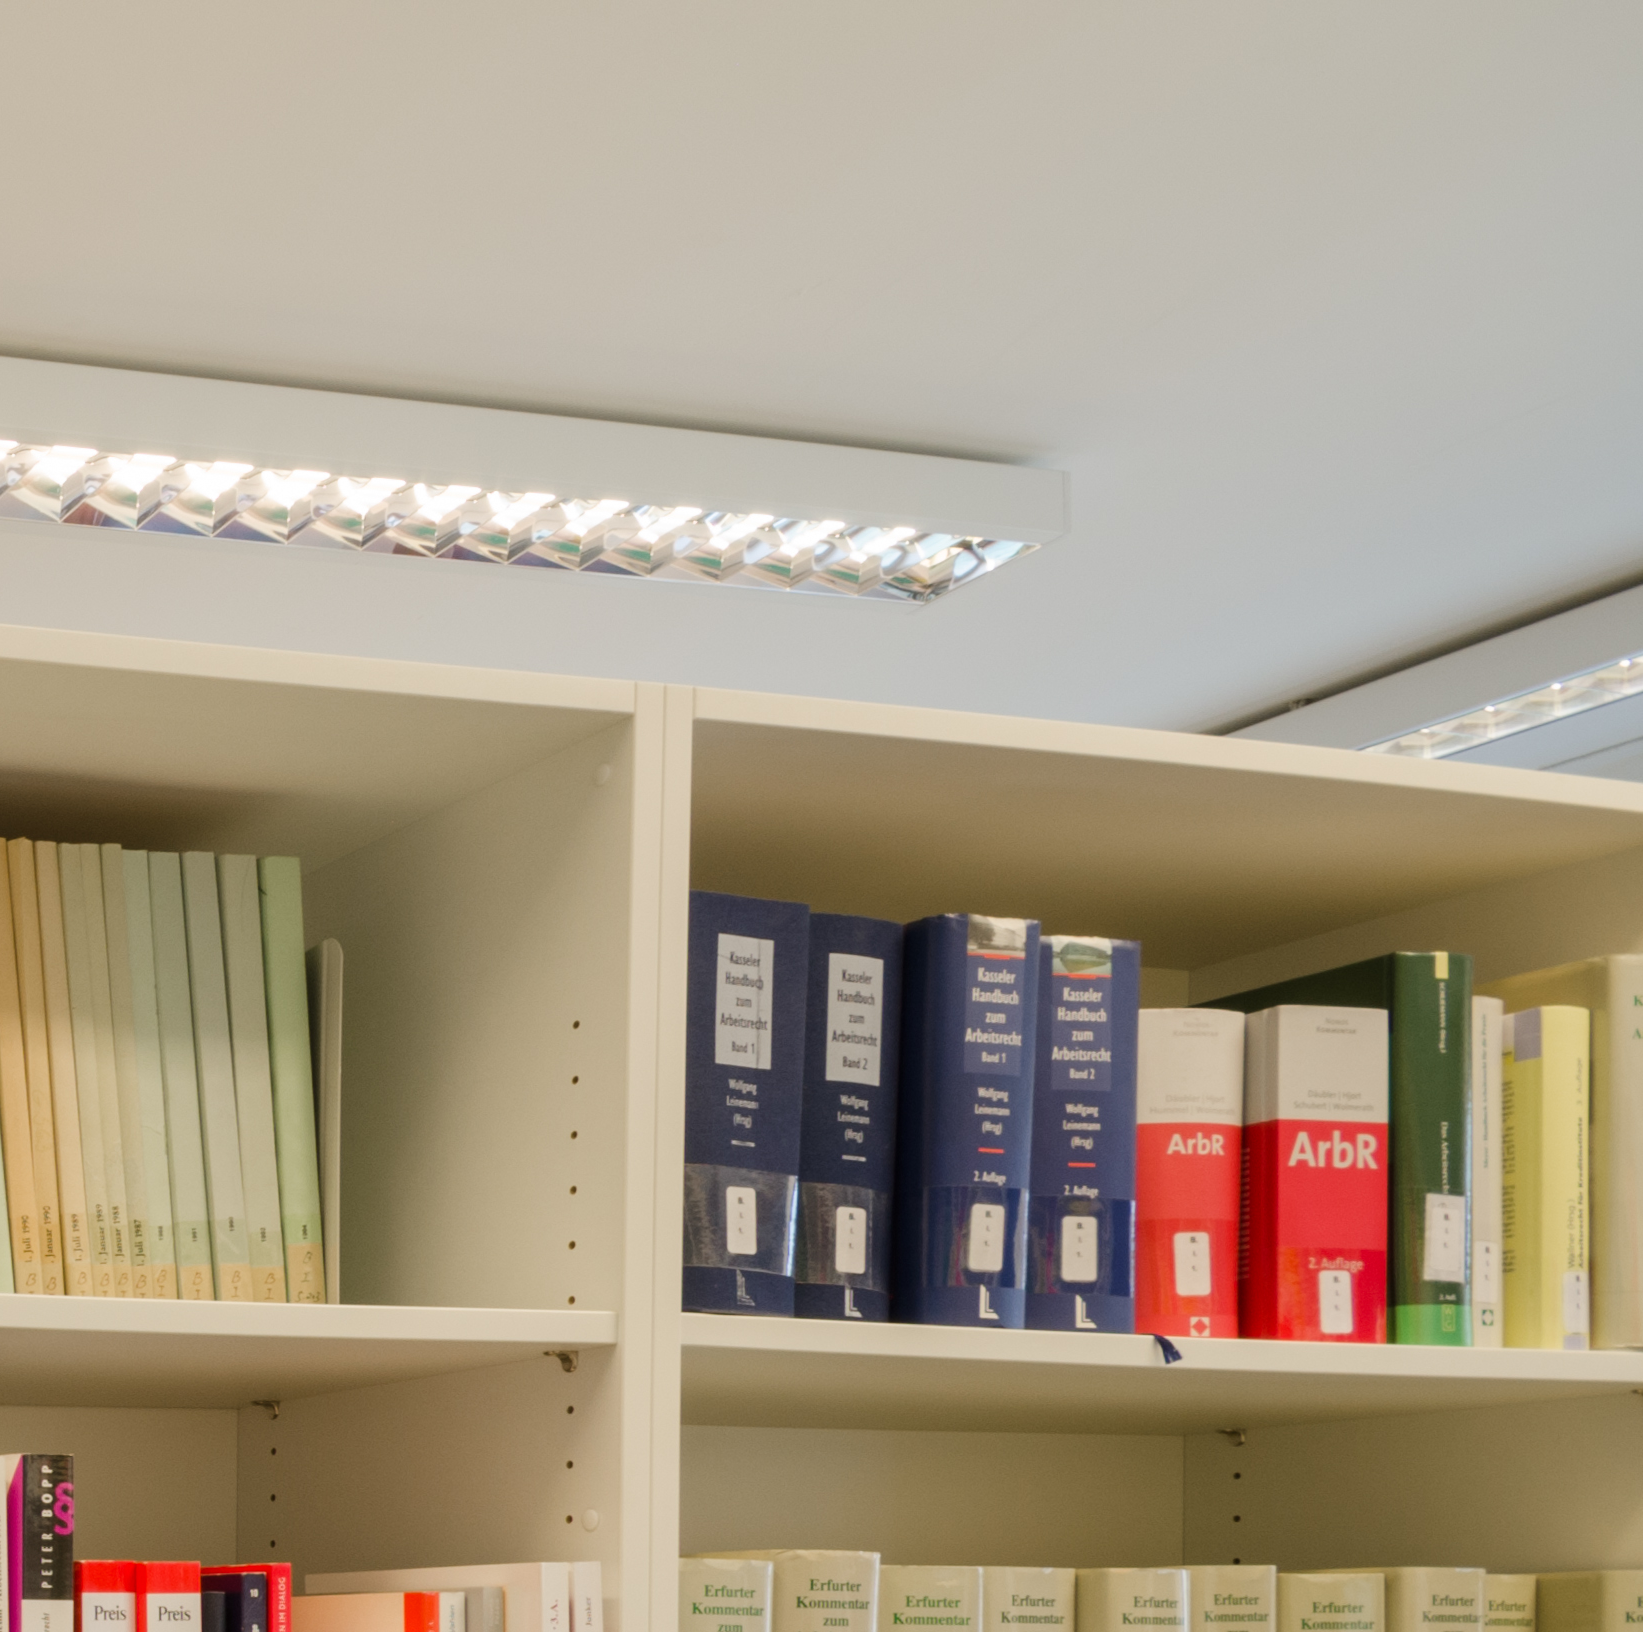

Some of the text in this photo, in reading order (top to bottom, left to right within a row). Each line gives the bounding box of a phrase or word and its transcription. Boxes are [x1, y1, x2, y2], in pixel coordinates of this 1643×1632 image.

[728, 951, 761, 968] Kasseler
[724, 971, 764, 990] Handbuch
[976, 966, 1017, 986] Kasseler
[735, 996, 753, 1009] zum
[971, 988, 1019, 1006] Handbuch
[719, 1014, 768, 1032] Arbeitsrecht
[985, 1010, 1007, 1025] zum
[965, 1027, 1022, 1047] Arbeitsrecht
[731, 1040, 756, 1055] Band 1
[981, 1051, 1007, 1064] Band 1
[1166, 1133, 1226, 1156] ArbR
[1287, 1130, 1379, 1170] ArbR
[1308, 1257, 1365, 1272] 2. Auflage
[41, 1463, 54, 1589] PETER BOPP
[278, 1577, 286, 1610] DIALOG
[703, 1584, 756, 1600] Erfurter
[691, 1602, 765, 1618] Kommentar
[904, 1595, 961, 1610] Erfurter
[93, 1604, 127, 1623] Preis
[157, 1605, 192, 1623] Preis
[278, 1612, 286, 1623] IM
[892, 1612, 972, 1627] Kommentar
